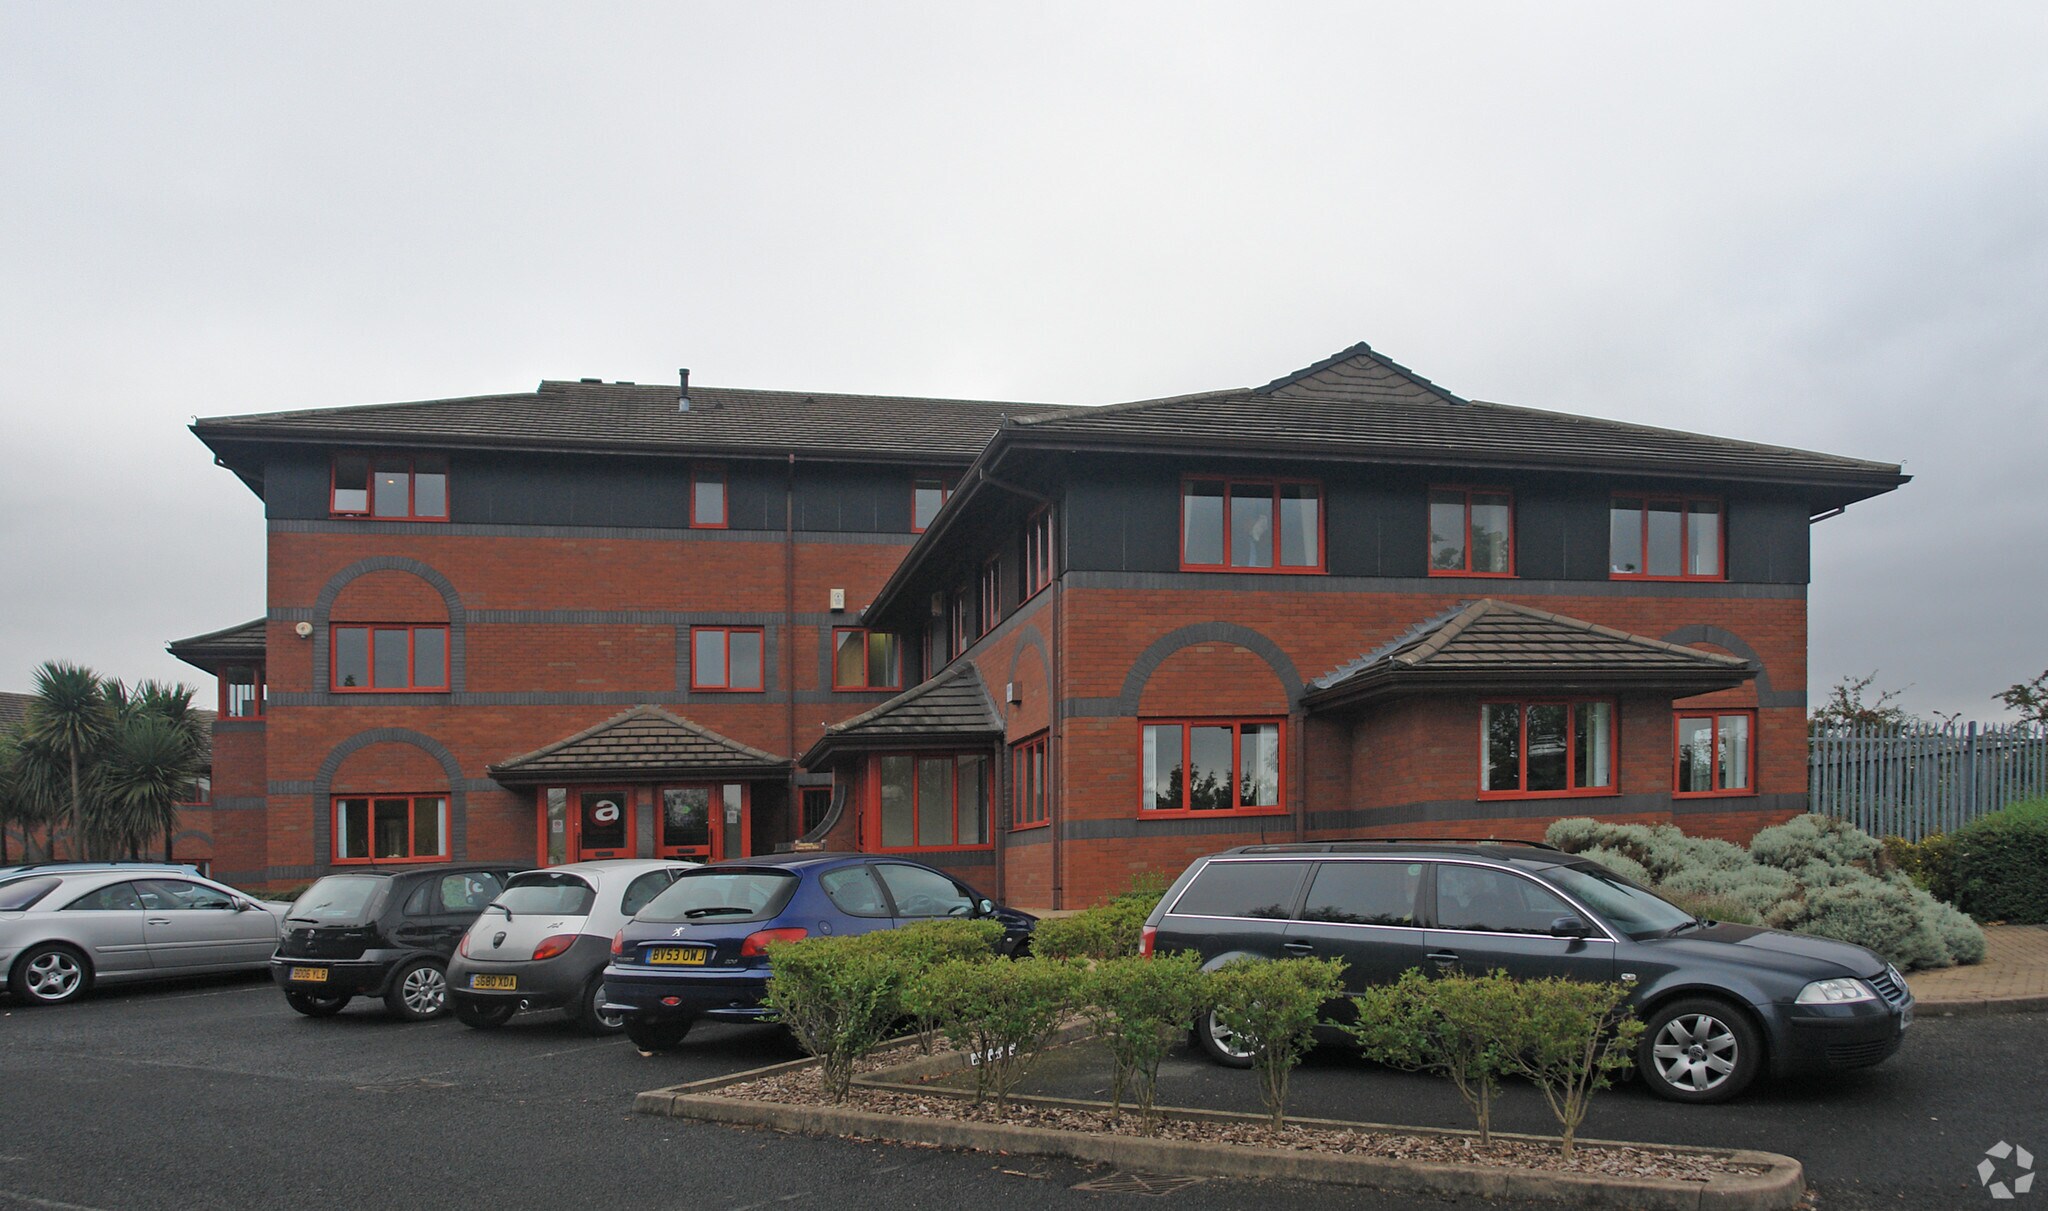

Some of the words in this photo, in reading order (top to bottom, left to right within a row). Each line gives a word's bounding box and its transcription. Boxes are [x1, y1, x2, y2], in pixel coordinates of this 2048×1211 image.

[595, 800, 619, 821] a
[652, 948, 680, 961] BV53
[682, 948, 706, 961] OWJ
[497, 976, 515, 988] XDA
